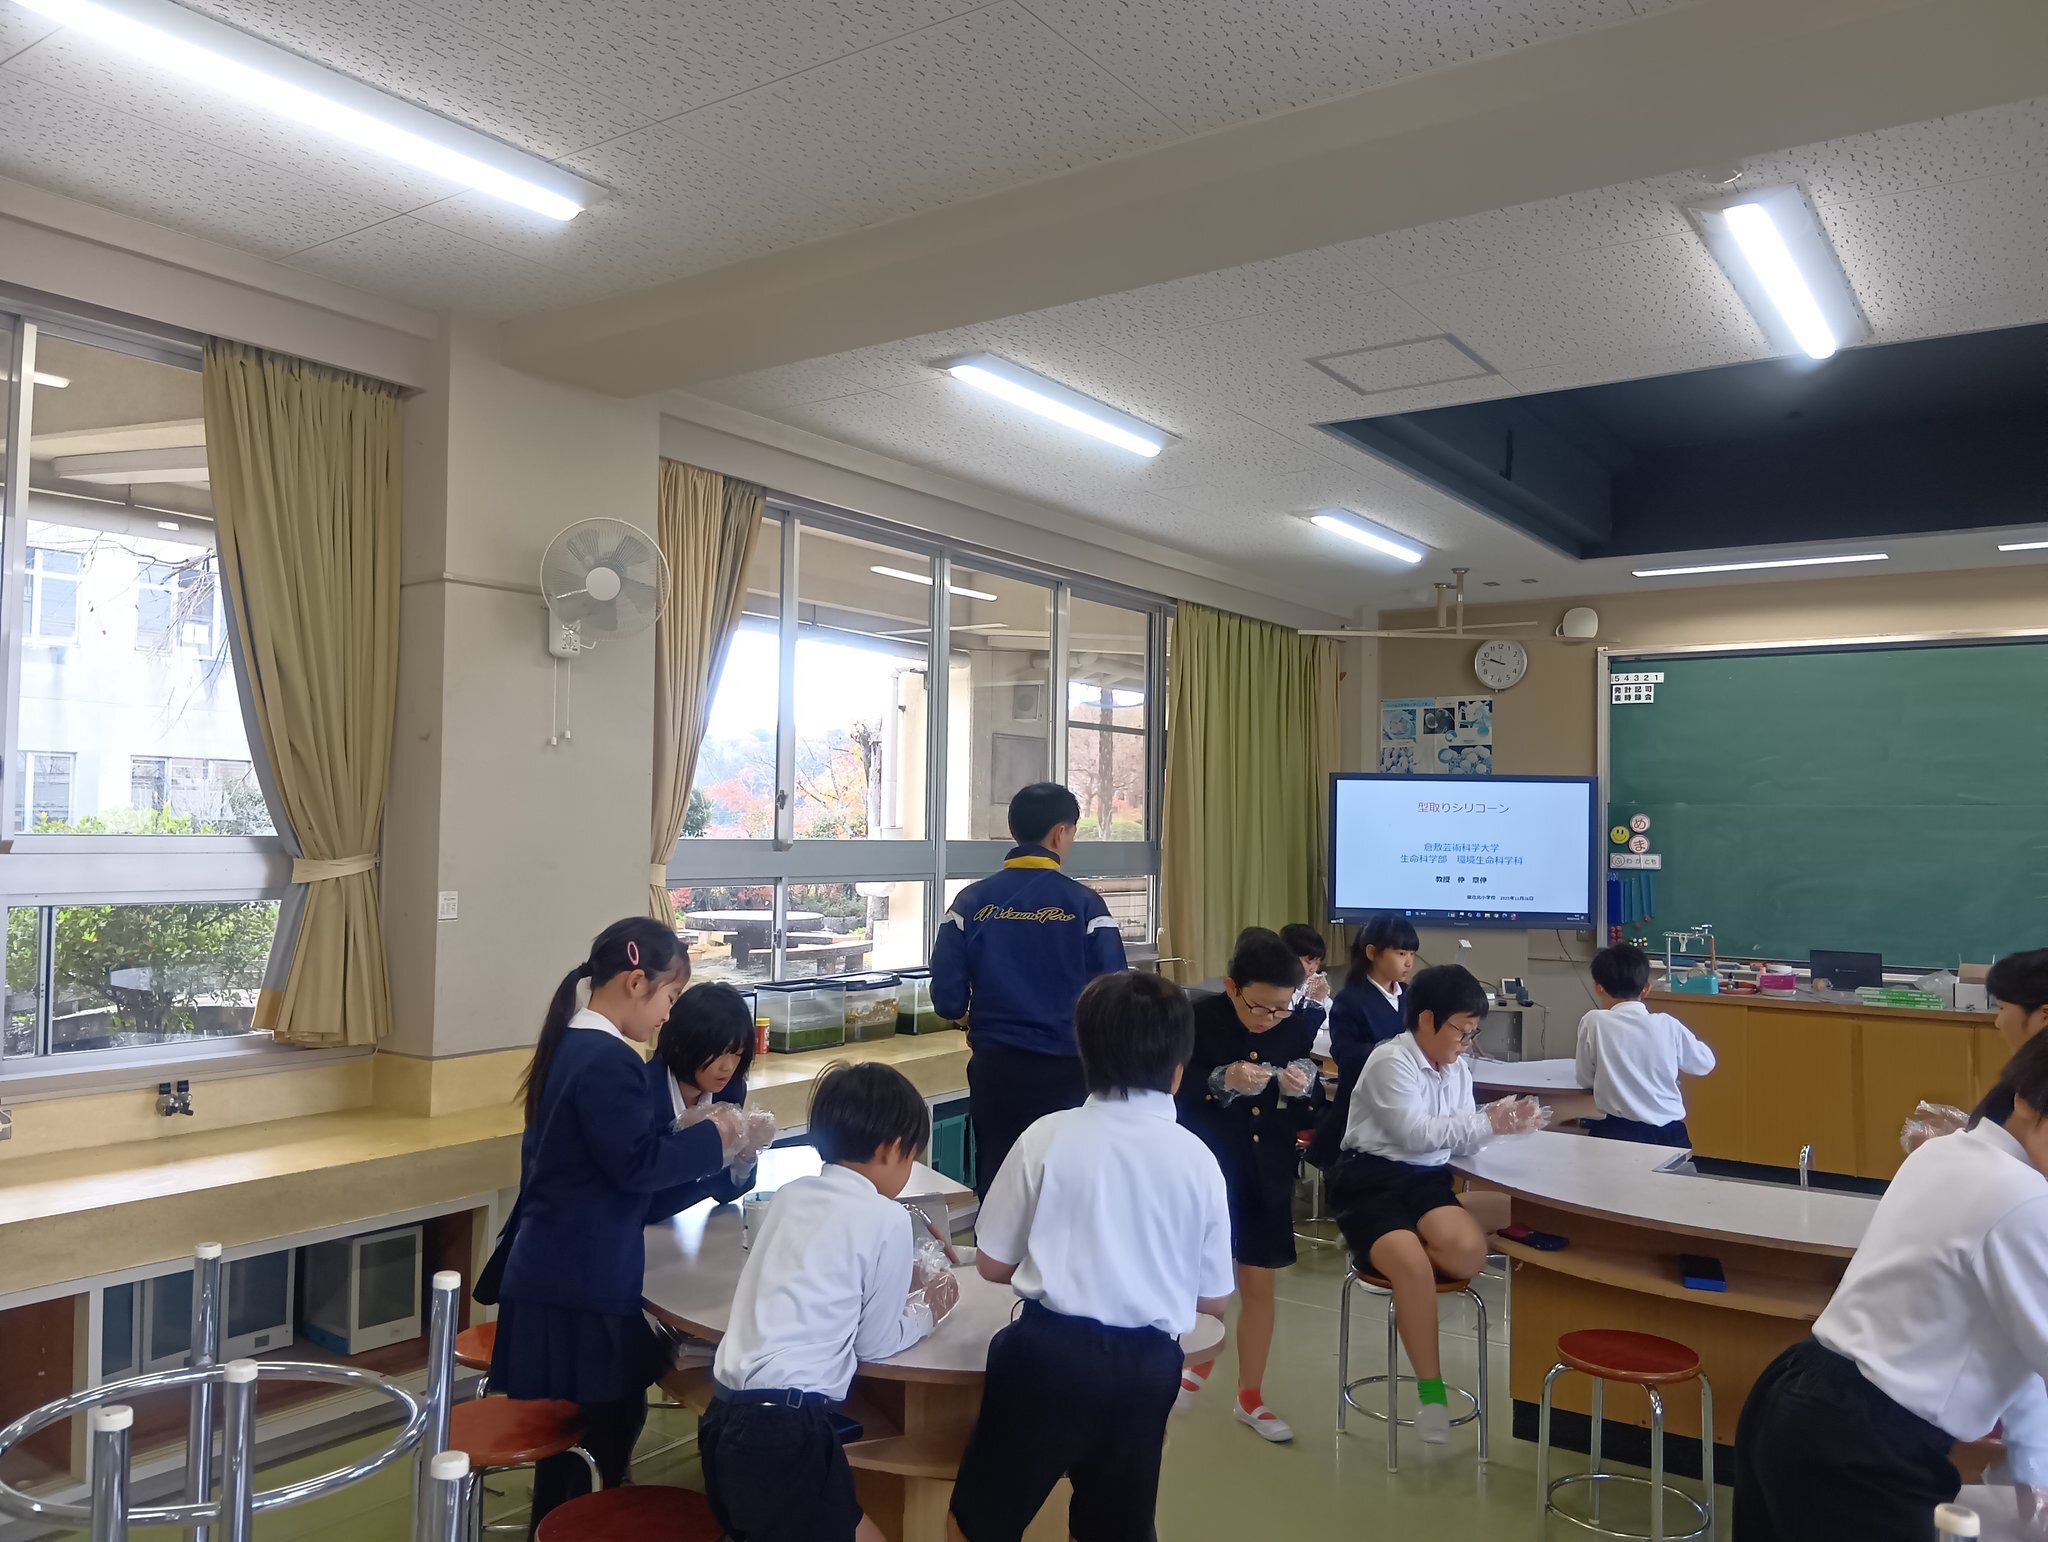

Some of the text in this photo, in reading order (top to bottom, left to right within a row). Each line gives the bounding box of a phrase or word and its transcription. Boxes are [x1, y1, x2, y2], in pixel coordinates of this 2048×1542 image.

[1417, 802, 1510, 814] 型取りシリコーン
[1633, 818, 1647, 830] め
[1424, 842, 1500, 852] 倉敷芸術科学大学
[1633, 840, 1646, 852] ま
[1400, 854, 1523, 865] 生命科学部 環境生命科学科
